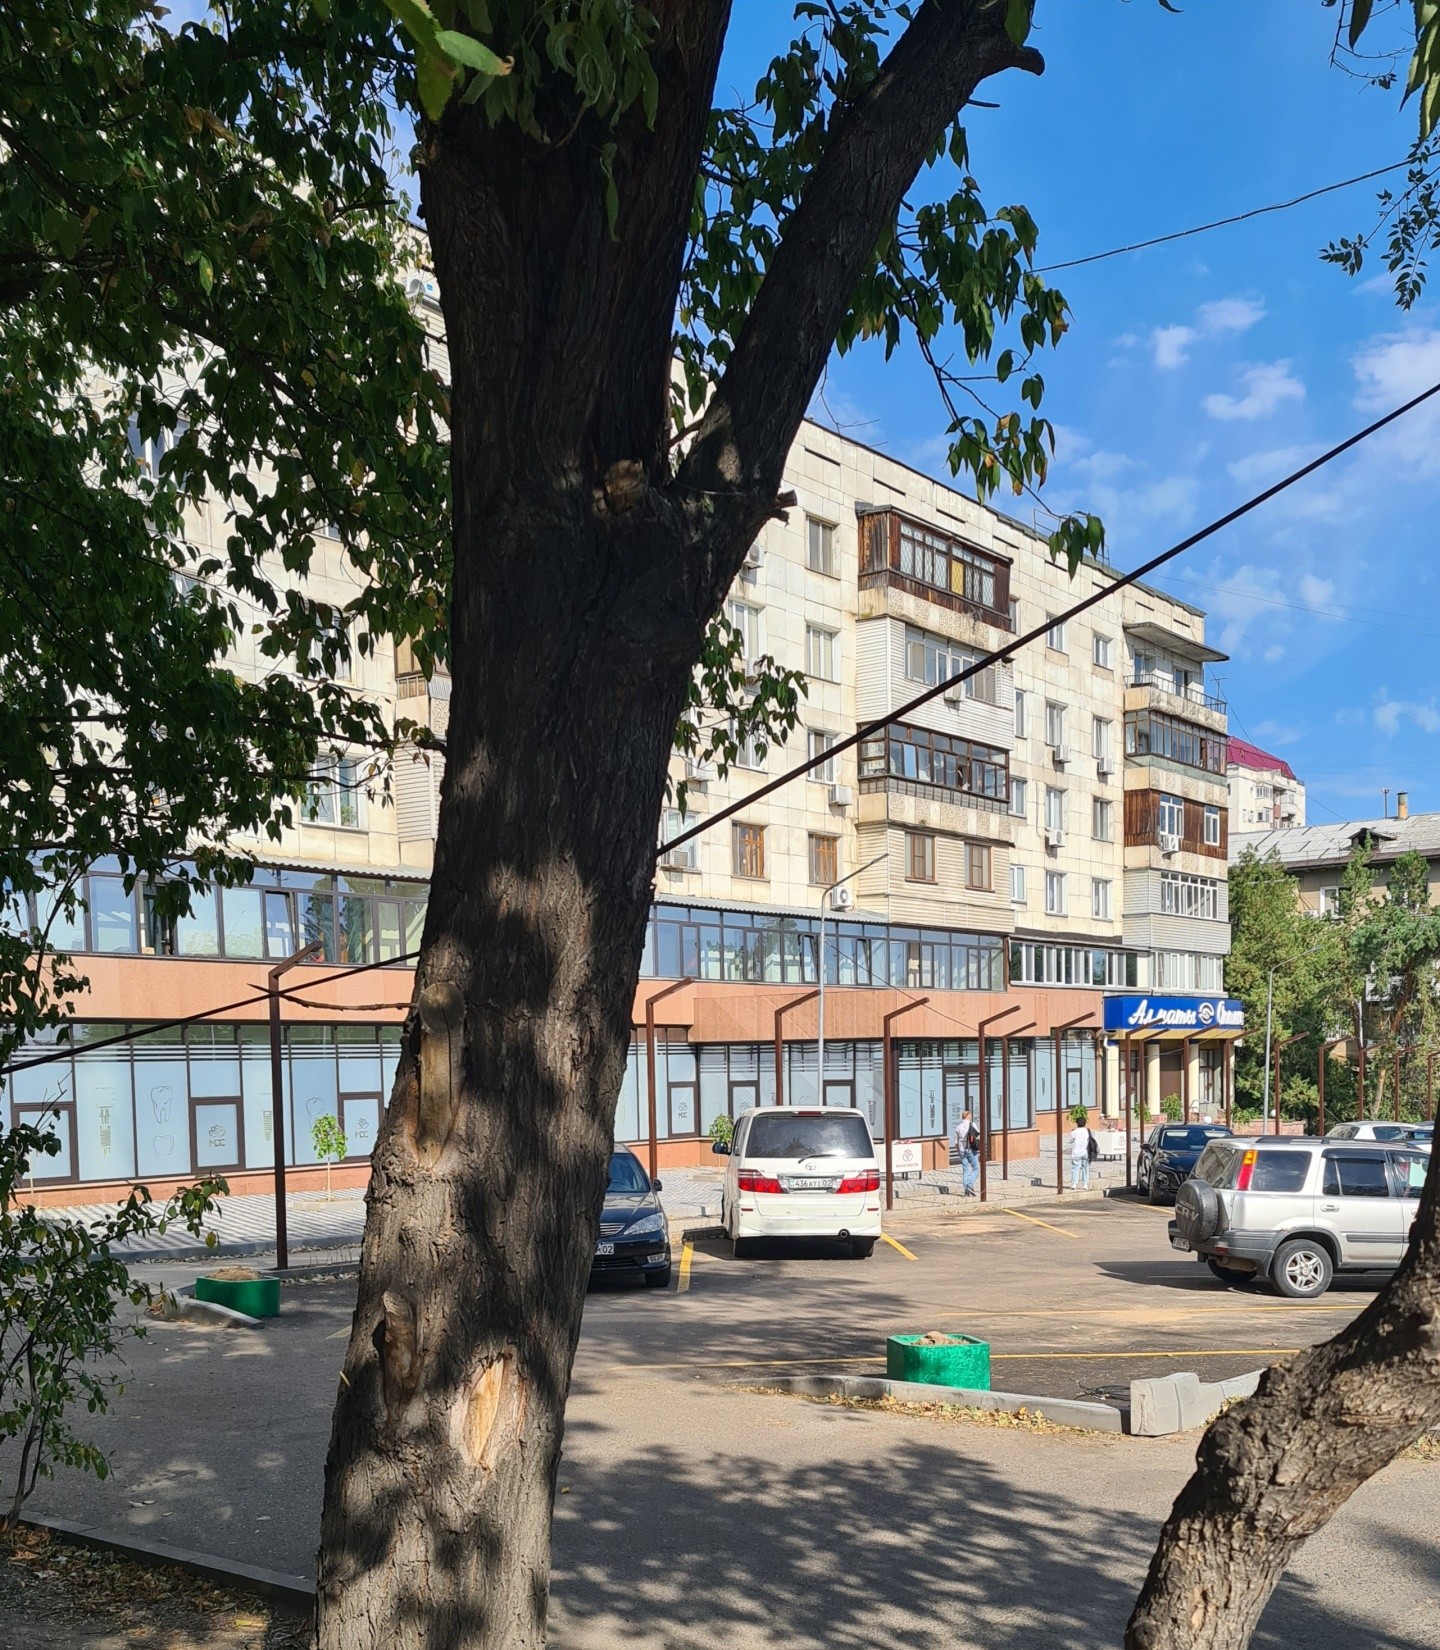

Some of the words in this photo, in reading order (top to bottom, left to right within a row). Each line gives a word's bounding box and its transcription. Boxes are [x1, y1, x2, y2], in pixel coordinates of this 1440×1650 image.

[1128, 999, 1197, 1025] Алматы
[1175, 1203, 1200, 1222] CR-V
[602, 1245, 613, 1254] 02
